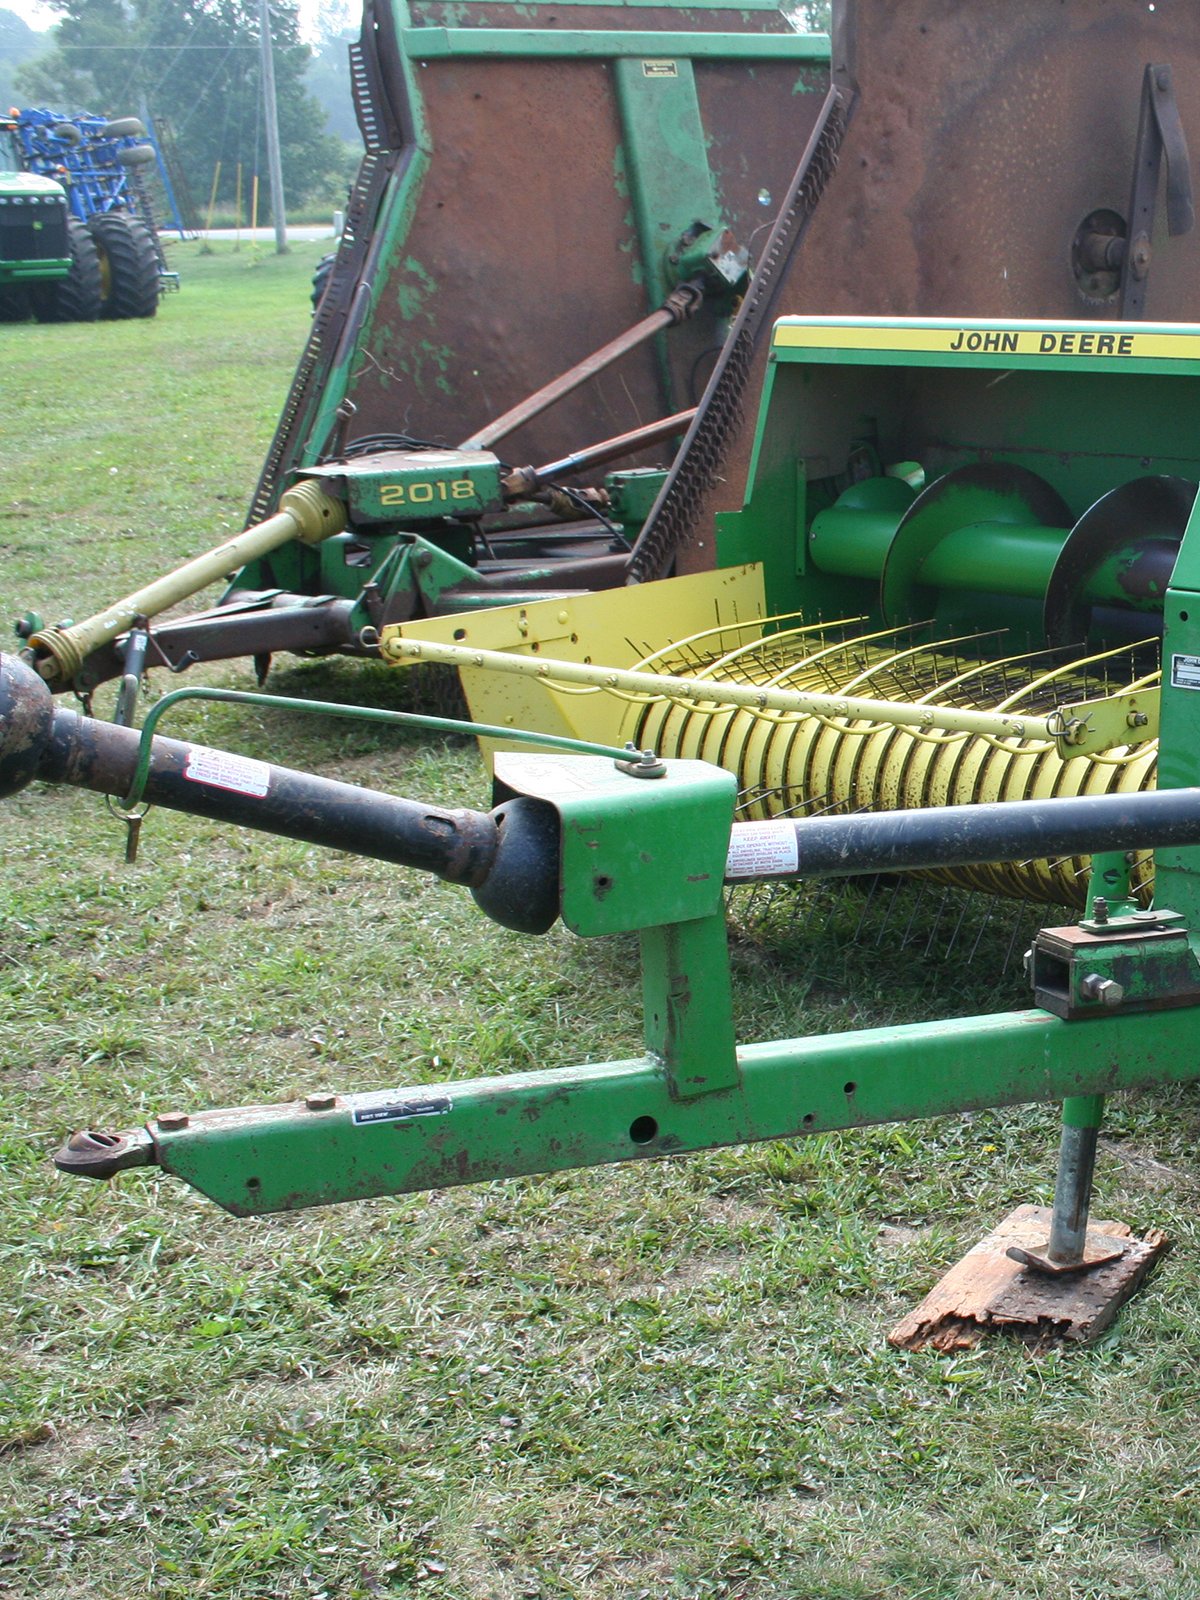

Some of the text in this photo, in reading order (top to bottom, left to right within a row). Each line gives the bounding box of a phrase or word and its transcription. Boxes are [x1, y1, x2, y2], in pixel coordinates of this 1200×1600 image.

[950, 332, 1134, 355] JOHN DEERE
[380, 480, 475, 506] 2018
